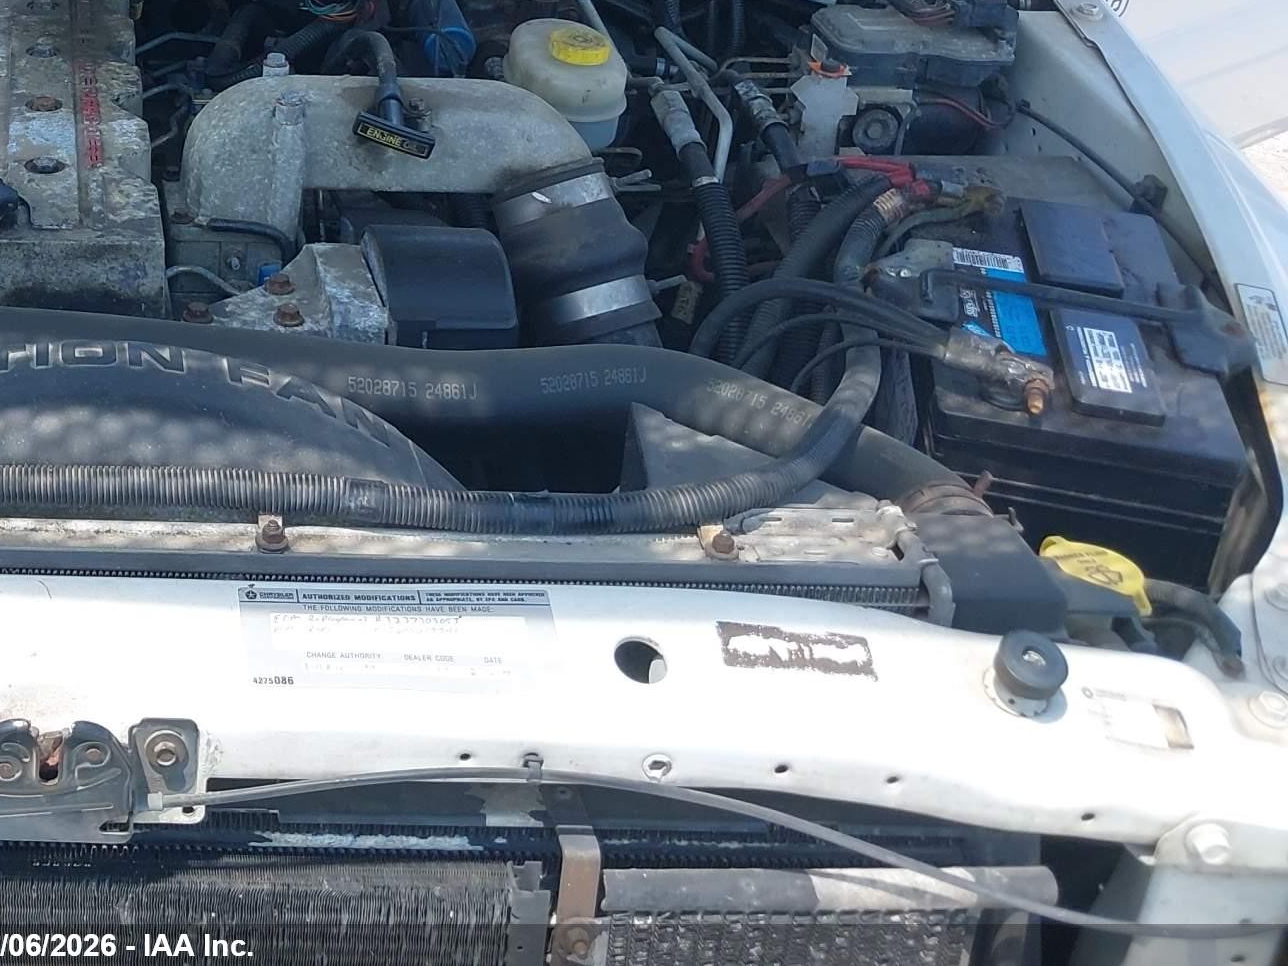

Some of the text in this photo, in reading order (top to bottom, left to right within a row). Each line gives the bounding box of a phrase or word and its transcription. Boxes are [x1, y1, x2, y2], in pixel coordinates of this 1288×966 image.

[366, 127, 402, 146] ENGINE
[348, 376, 478, 400] 52028715 24861J
[540, 371, 599, 394] 52028715
[222, 357, 391, 450] FAN
[302, 593, 351, 601] AUTHORIZED
[354, 594, 416, 602] MODIFICATIONS
[306, 651, 382, 660] CHANGE AUTHORITY
[434, 654, 455, 662] CODE
[252, 675, 295, 685] 4275086
